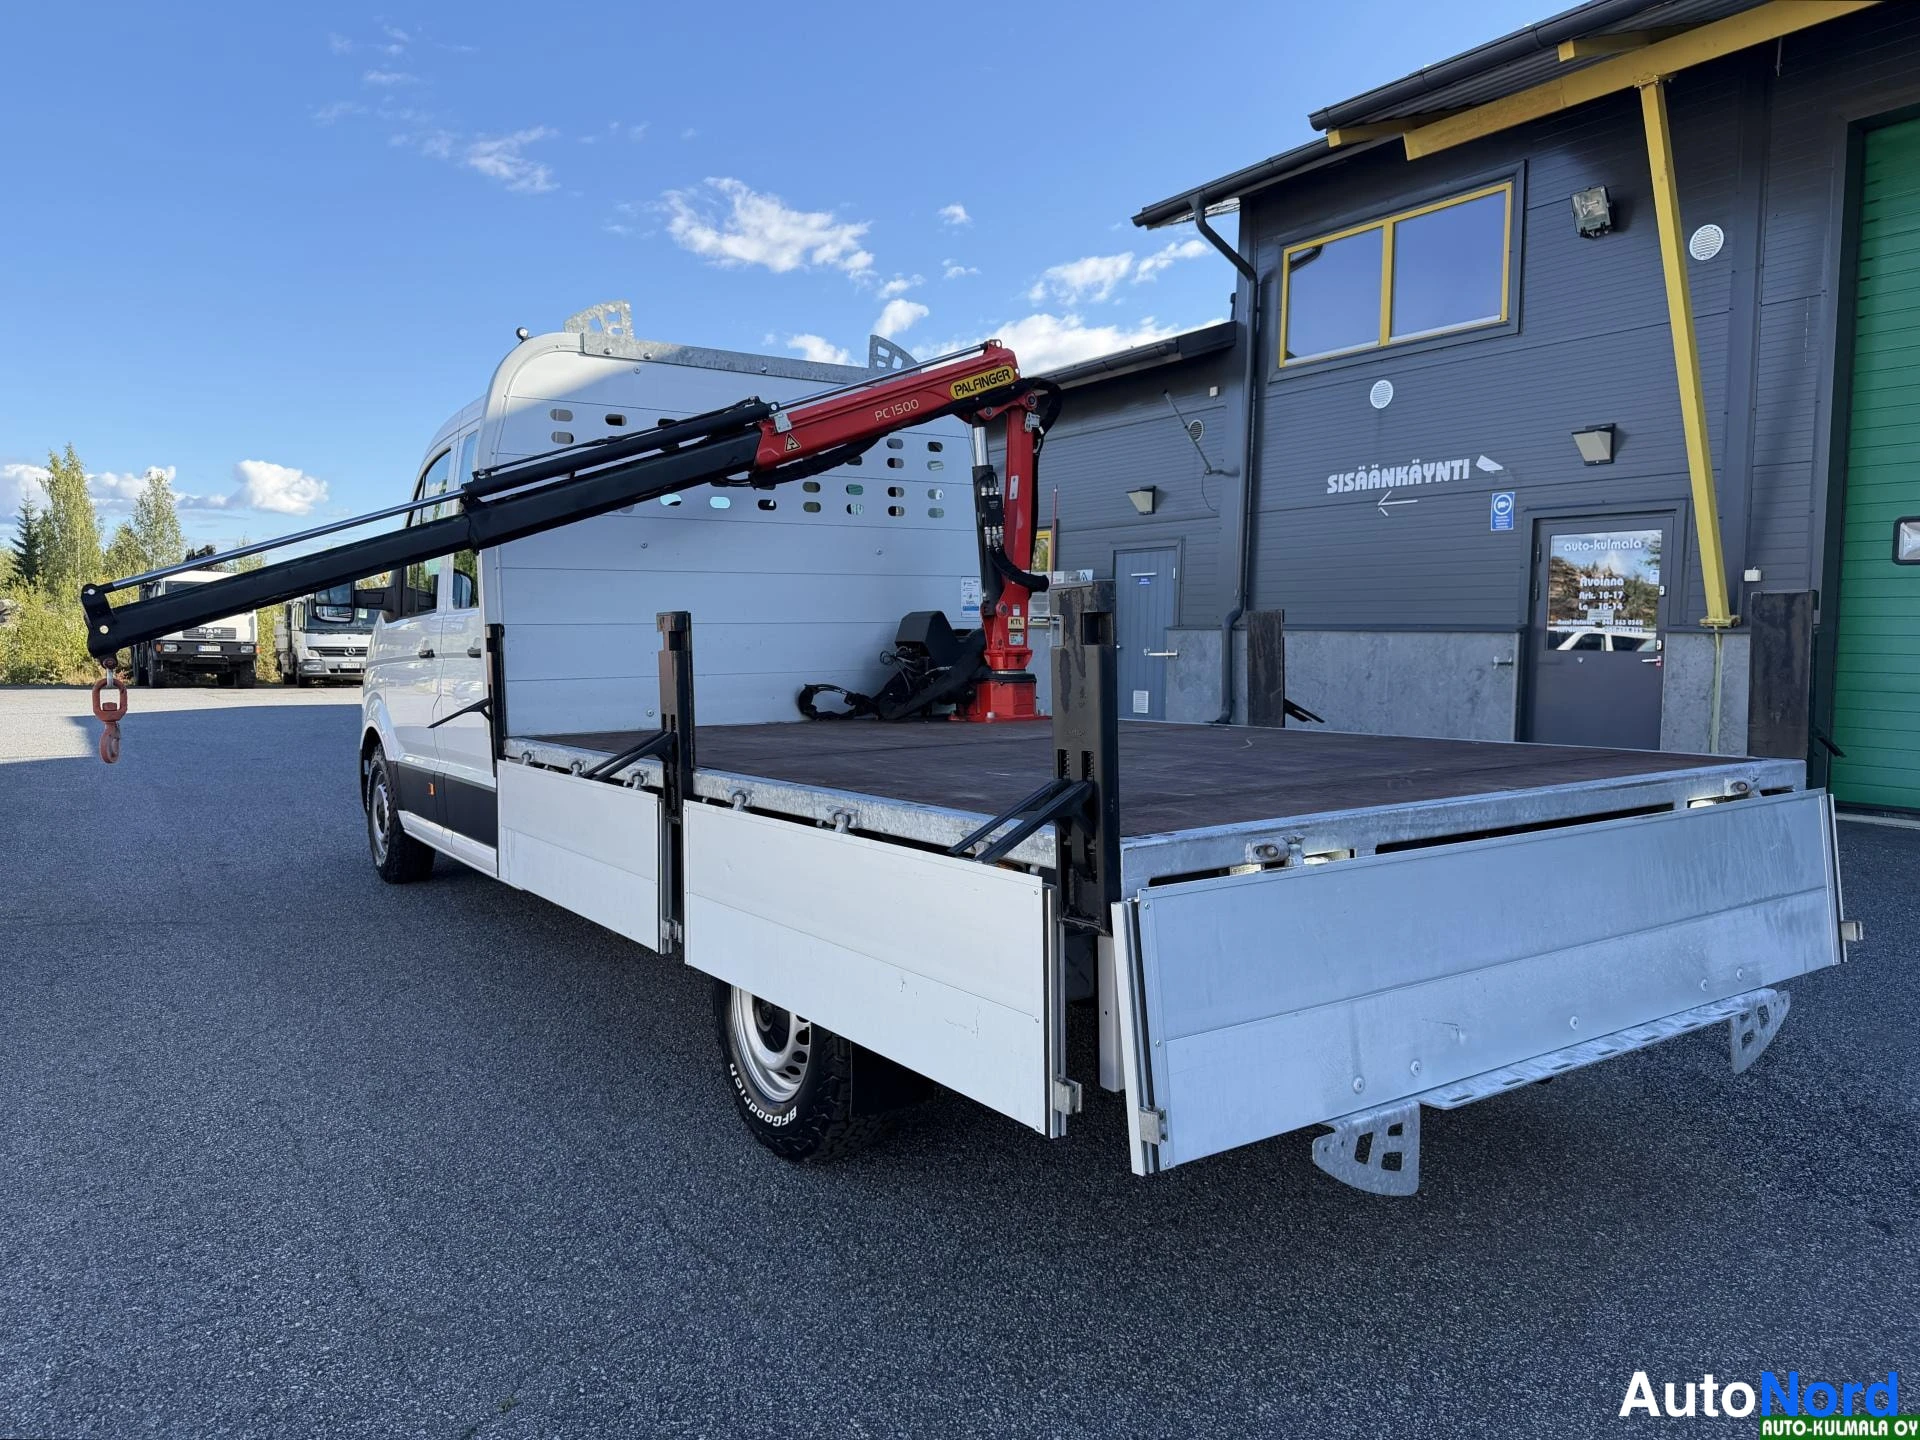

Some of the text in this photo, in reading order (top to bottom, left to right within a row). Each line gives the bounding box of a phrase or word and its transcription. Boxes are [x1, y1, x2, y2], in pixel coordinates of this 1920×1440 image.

[954, 368, 1011, 396] PALFINGER
[1327, 458, 1470, 494] SISÄÄNKÄYNTI
[1564, 538, 1642, 552] auto-kulmala
[1580, 576, 1624, 587] Avoinna
[730, 1063, 797, 1127] BFGoodrich
